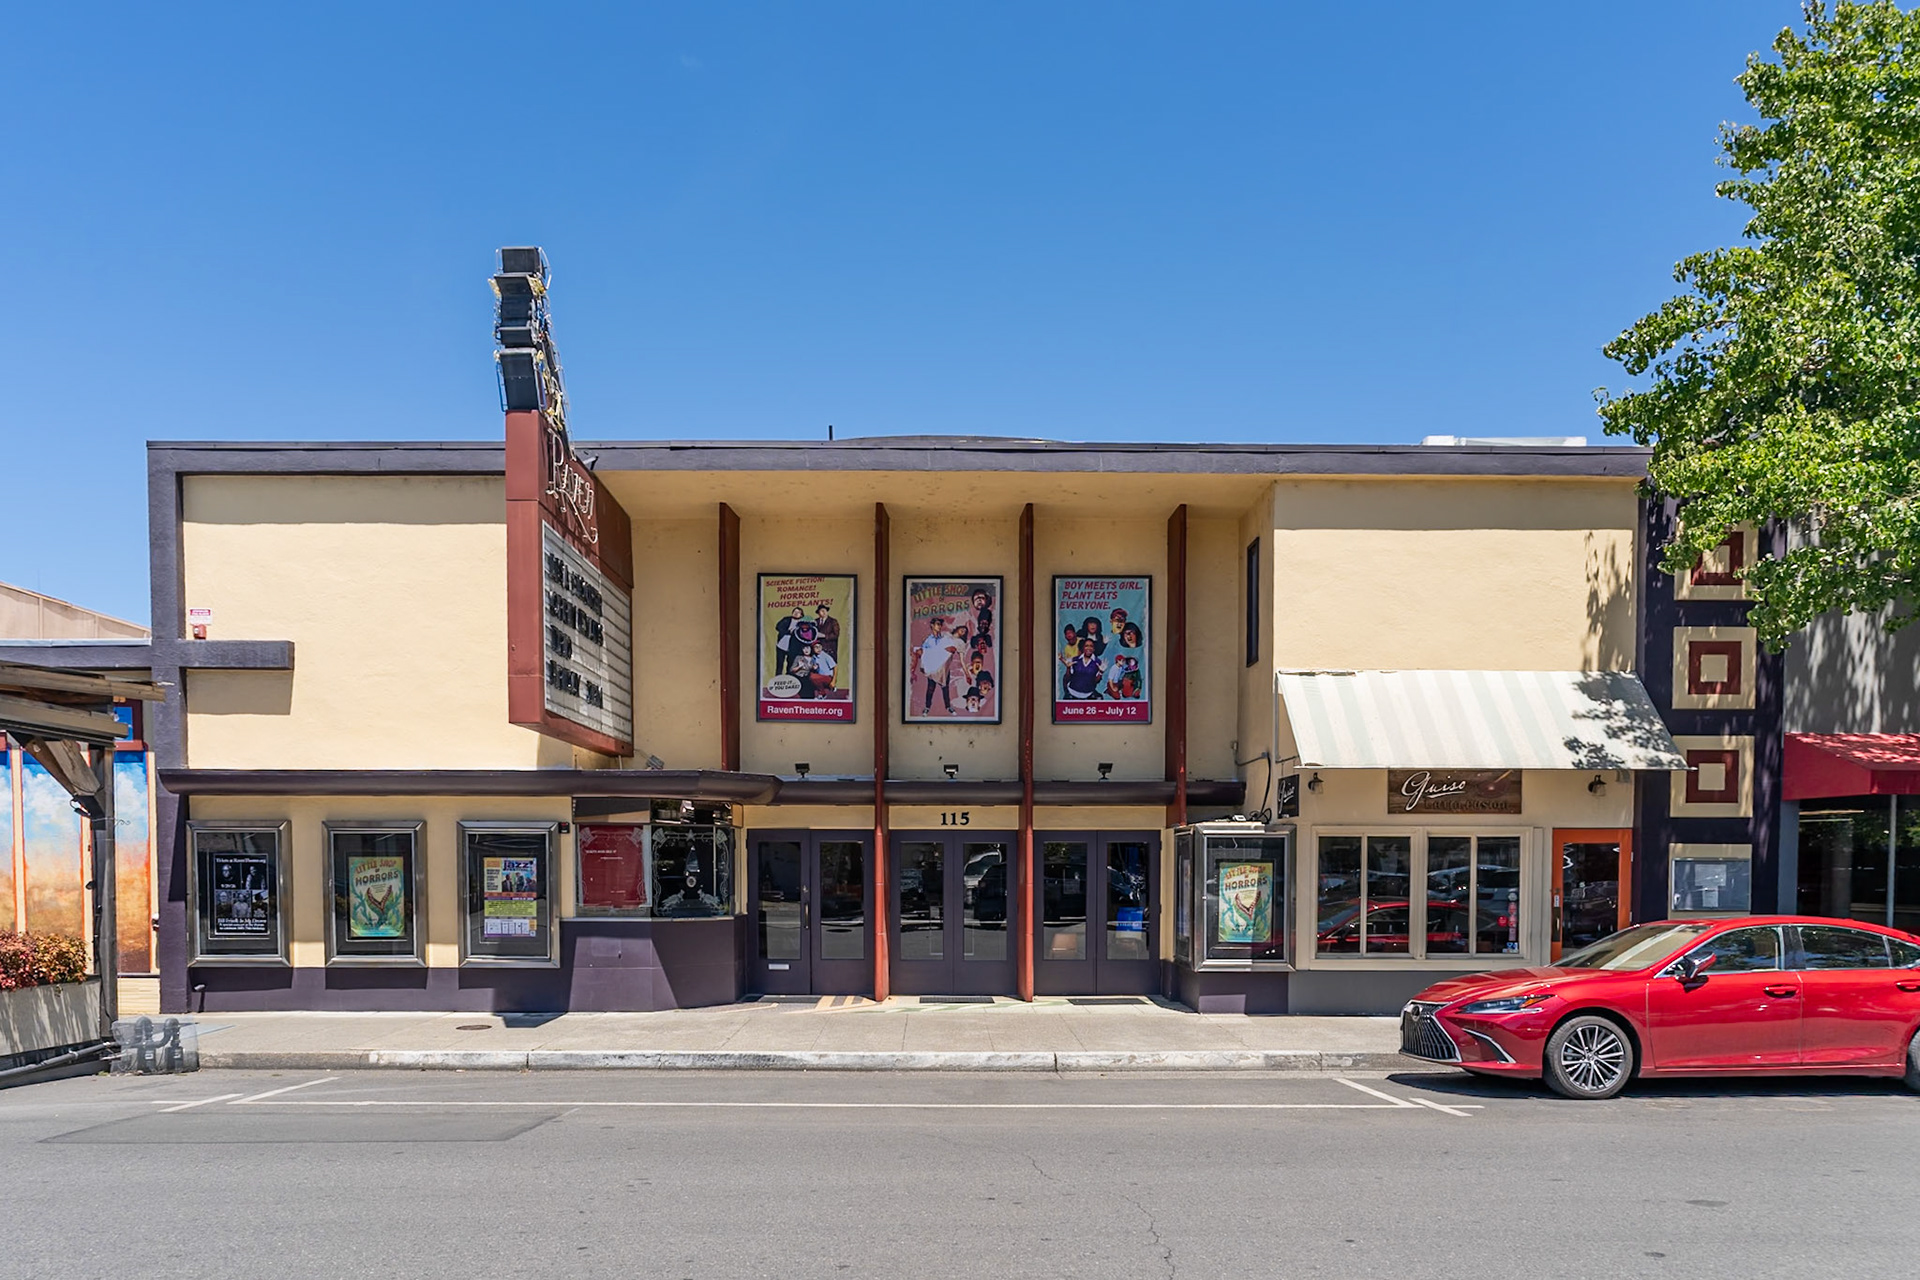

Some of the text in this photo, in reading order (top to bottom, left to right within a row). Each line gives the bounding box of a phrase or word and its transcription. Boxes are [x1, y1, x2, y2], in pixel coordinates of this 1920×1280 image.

[766, 576, 825, 587] SCIENCE FICTION!
[1064, 581, 1142, 590] BOY MEETS GIRL.
[777, 585, 816, 593] ROMANCE!
[944, 584, 969, 596] SHOP
[780, 592, 819, 600] HORROR!
[1062, 591, 1118, 600] PLANT EATS
[767, 599, 833, 608] HOUSEPLANTS!
[913, 600, 970, 618] HORRORS
[1059, 601, 1111, 610] EVERYONE.
[767, 705, 843, 717] RavenTheater.org
[1062, 706, 1084, 715] June
[1086, 706, 1097, 715] 26
[1105, 706, 1124, 717] July
[1126, 706, 1137, 715] 12
[1401, 771, 1466, 811] Guiso
[940, 811, 970, 826] 115
[380, 859, 396, 868] SHOP
[356, 870, 399, 887] HORRORS
[1225, 876, 1268, 891] HORRORS
